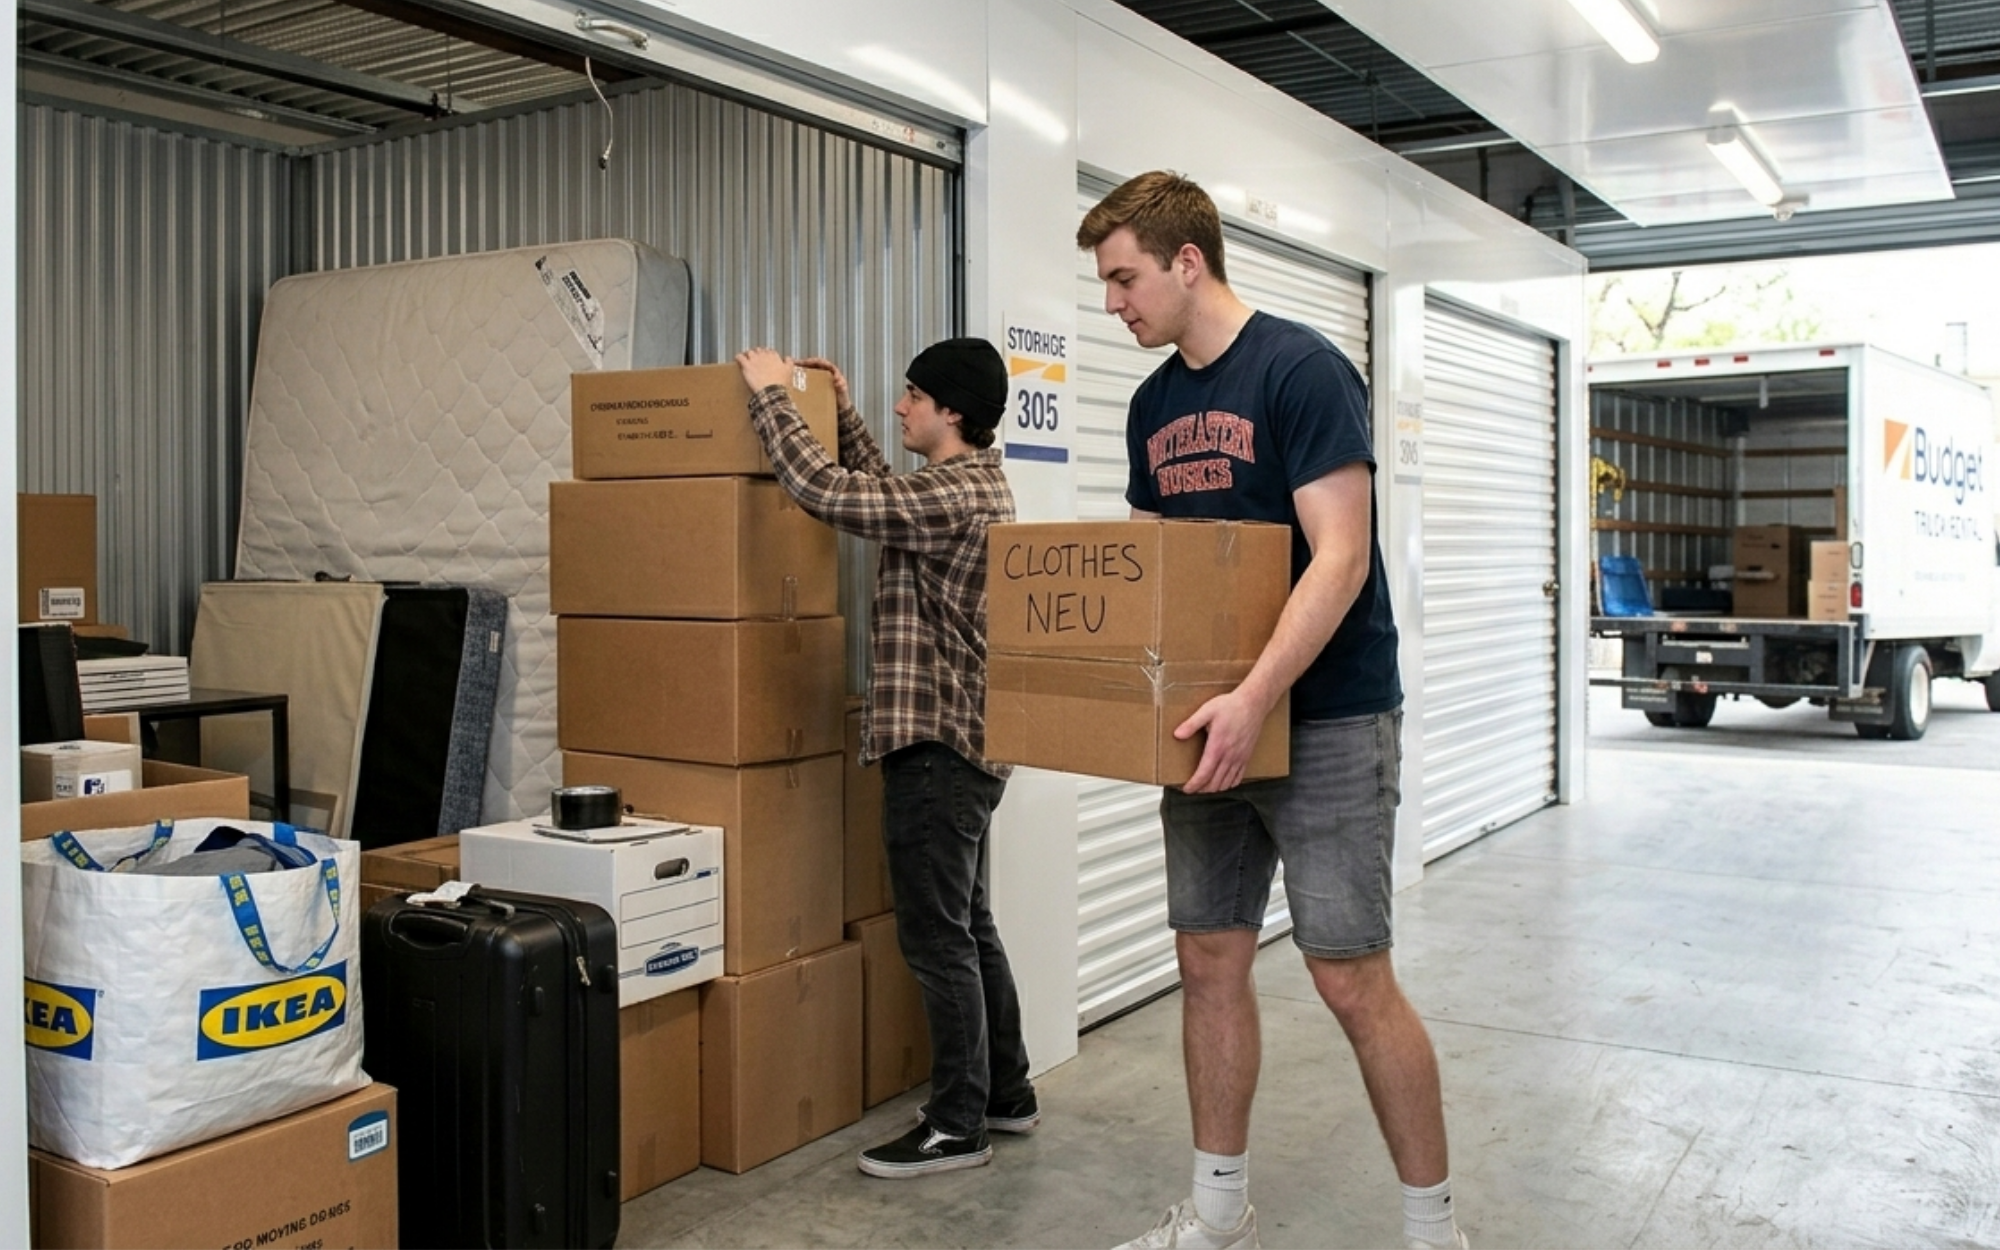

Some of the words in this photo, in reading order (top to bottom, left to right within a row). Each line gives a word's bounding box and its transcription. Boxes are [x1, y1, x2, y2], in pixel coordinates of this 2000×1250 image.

[1018, 389, 1059, 431] 305
[1915, 427, 1983, 505] Budget
[1004, 543, 1143, 582] CLOTHES
[1027, 592, 1105, 633] NEU
[24, 998, 78, 1035] EA
[222, 986, 336, 1034] IKEA
